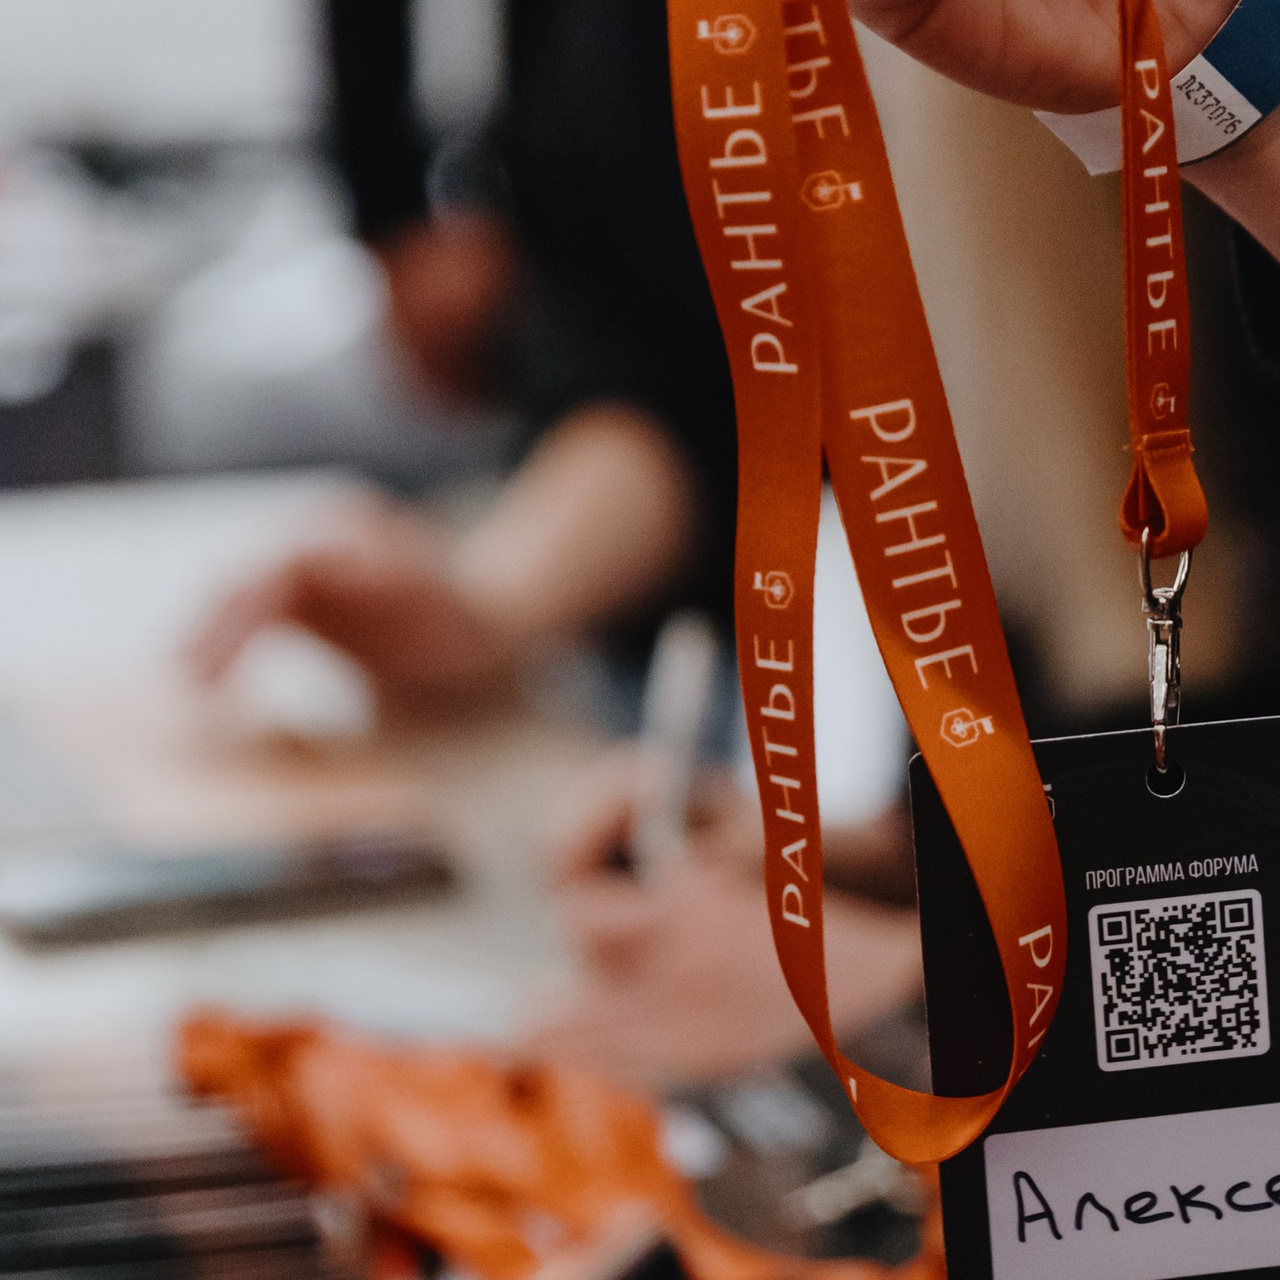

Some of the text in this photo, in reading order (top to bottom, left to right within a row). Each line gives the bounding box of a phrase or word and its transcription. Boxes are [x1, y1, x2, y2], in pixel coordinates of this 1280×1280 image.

[700, 80, 798, 375] РАНТЬЕ
[1134, 59, 1178, 358] РАНТЬЕ
[849, 398, 978, 692] РАНТЬЕ
[752, 636, 812, 928] РАНТЬЕ
[1085, 854, 1259, 890] ПРОГРАММА ФОРУМА
